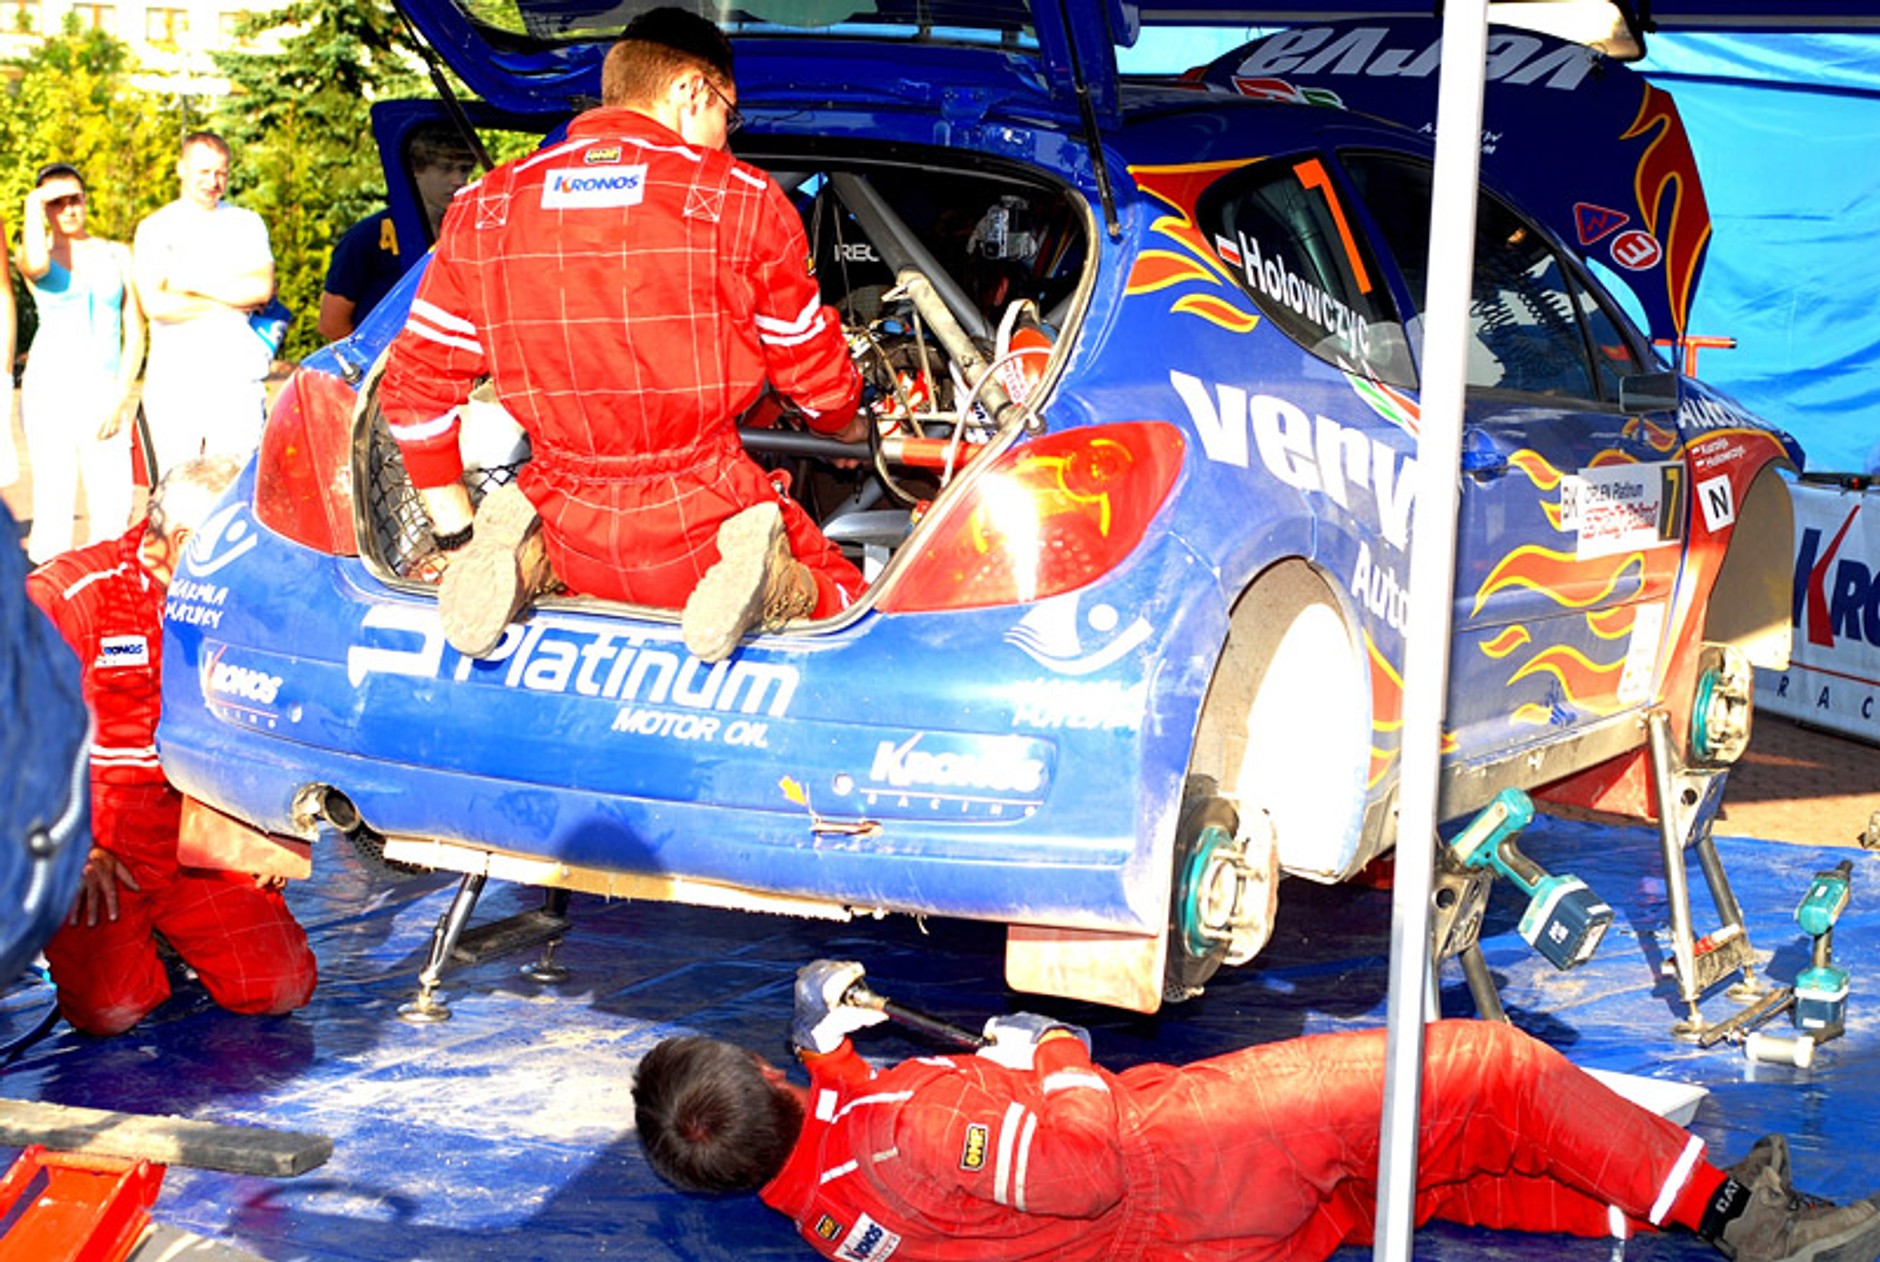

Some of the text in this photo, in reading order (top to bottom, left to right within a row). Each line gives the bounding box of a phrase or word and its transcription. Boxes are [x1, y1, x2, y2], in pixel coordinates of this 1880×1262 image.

[553, 175, 639, 194] KRONOS
[1616, 235, 1655, 265] E
[1666, 468, 1681, 539] 7
[1708, 485, 1729, 519] N
[611, 708, 769, 749] MOTOR OIL
